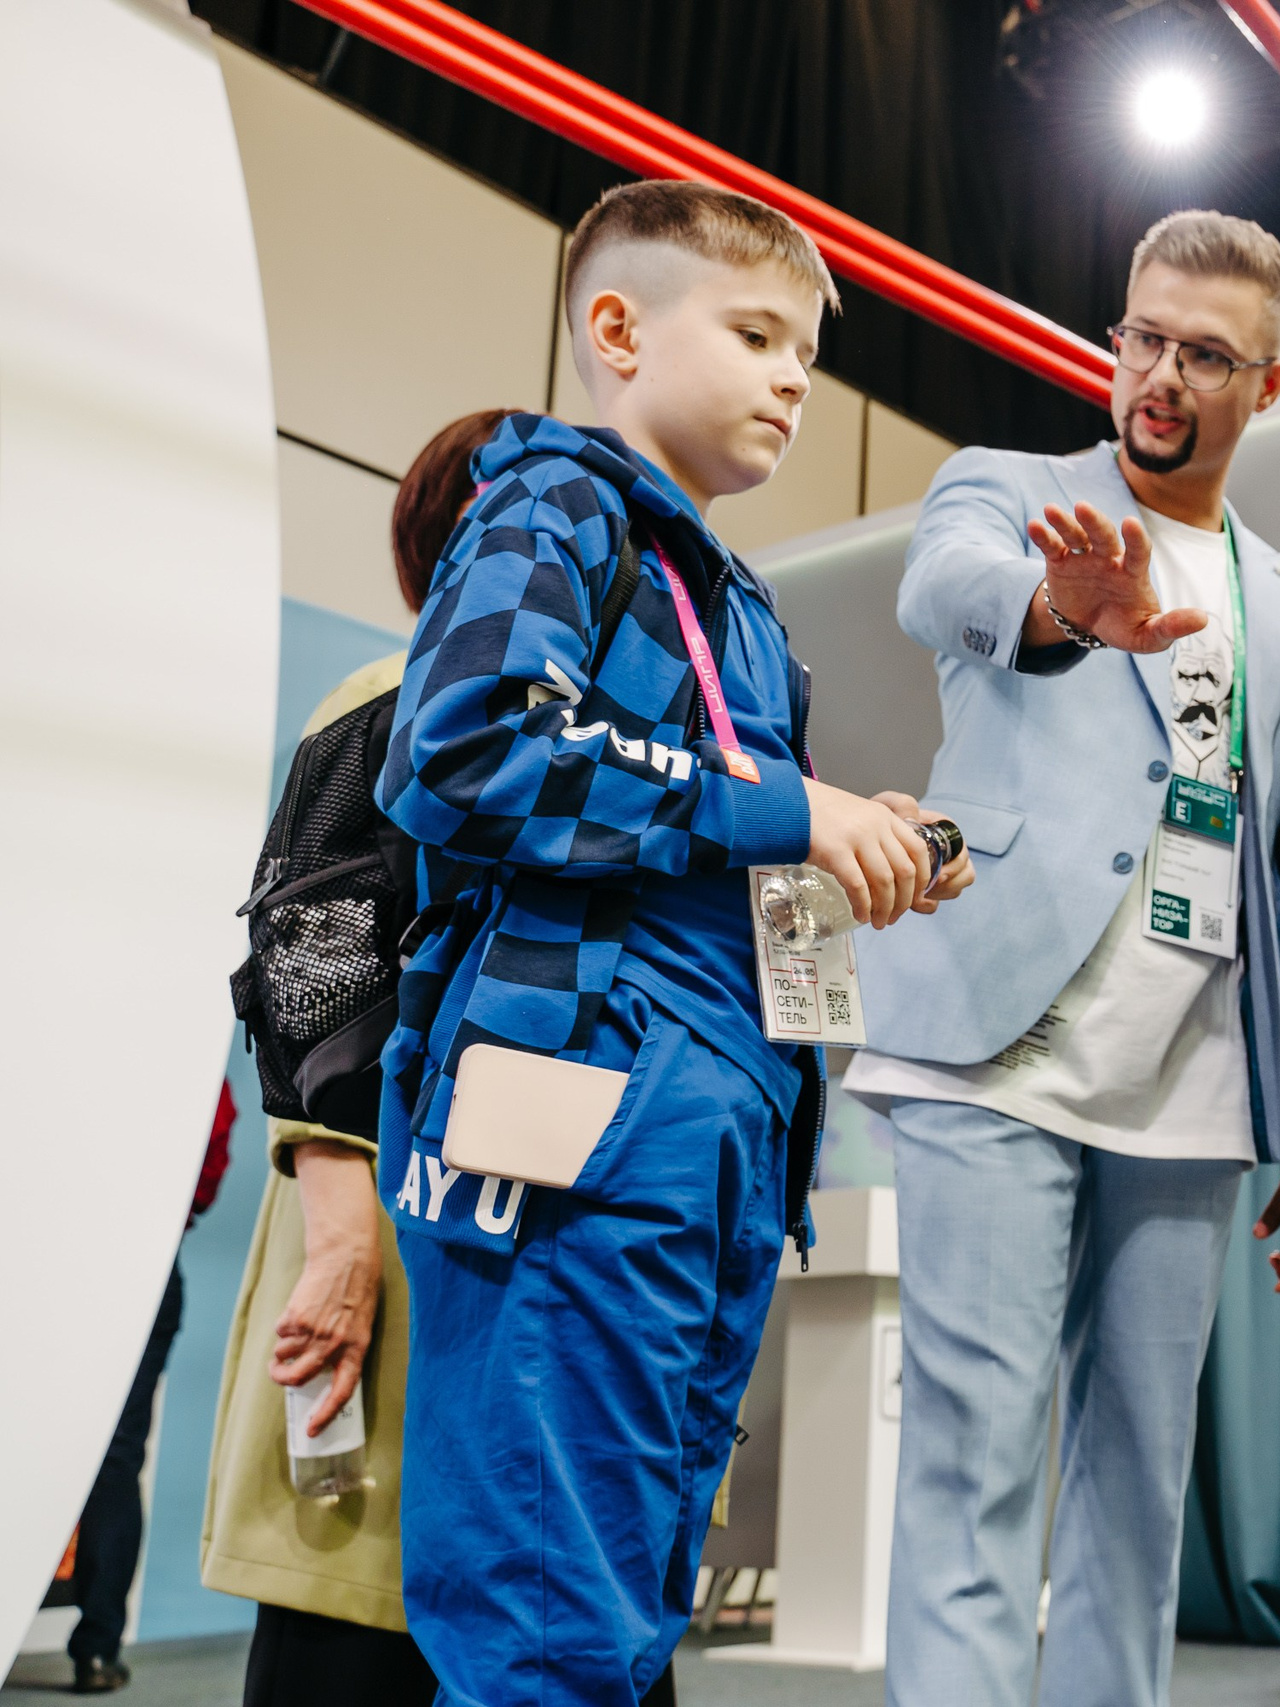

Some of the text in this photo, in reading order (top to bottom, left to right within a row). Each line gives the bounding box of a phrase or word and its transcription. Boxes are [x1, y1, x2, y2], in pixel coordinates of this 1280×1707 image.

[774, 978, 798, 992] ПО-
[776, 995, 814, 1009] СЕТИ-
[778, 1012, 807, 1025] ТЕЛЬ
[396, 1150, 526, 1240] AY U
